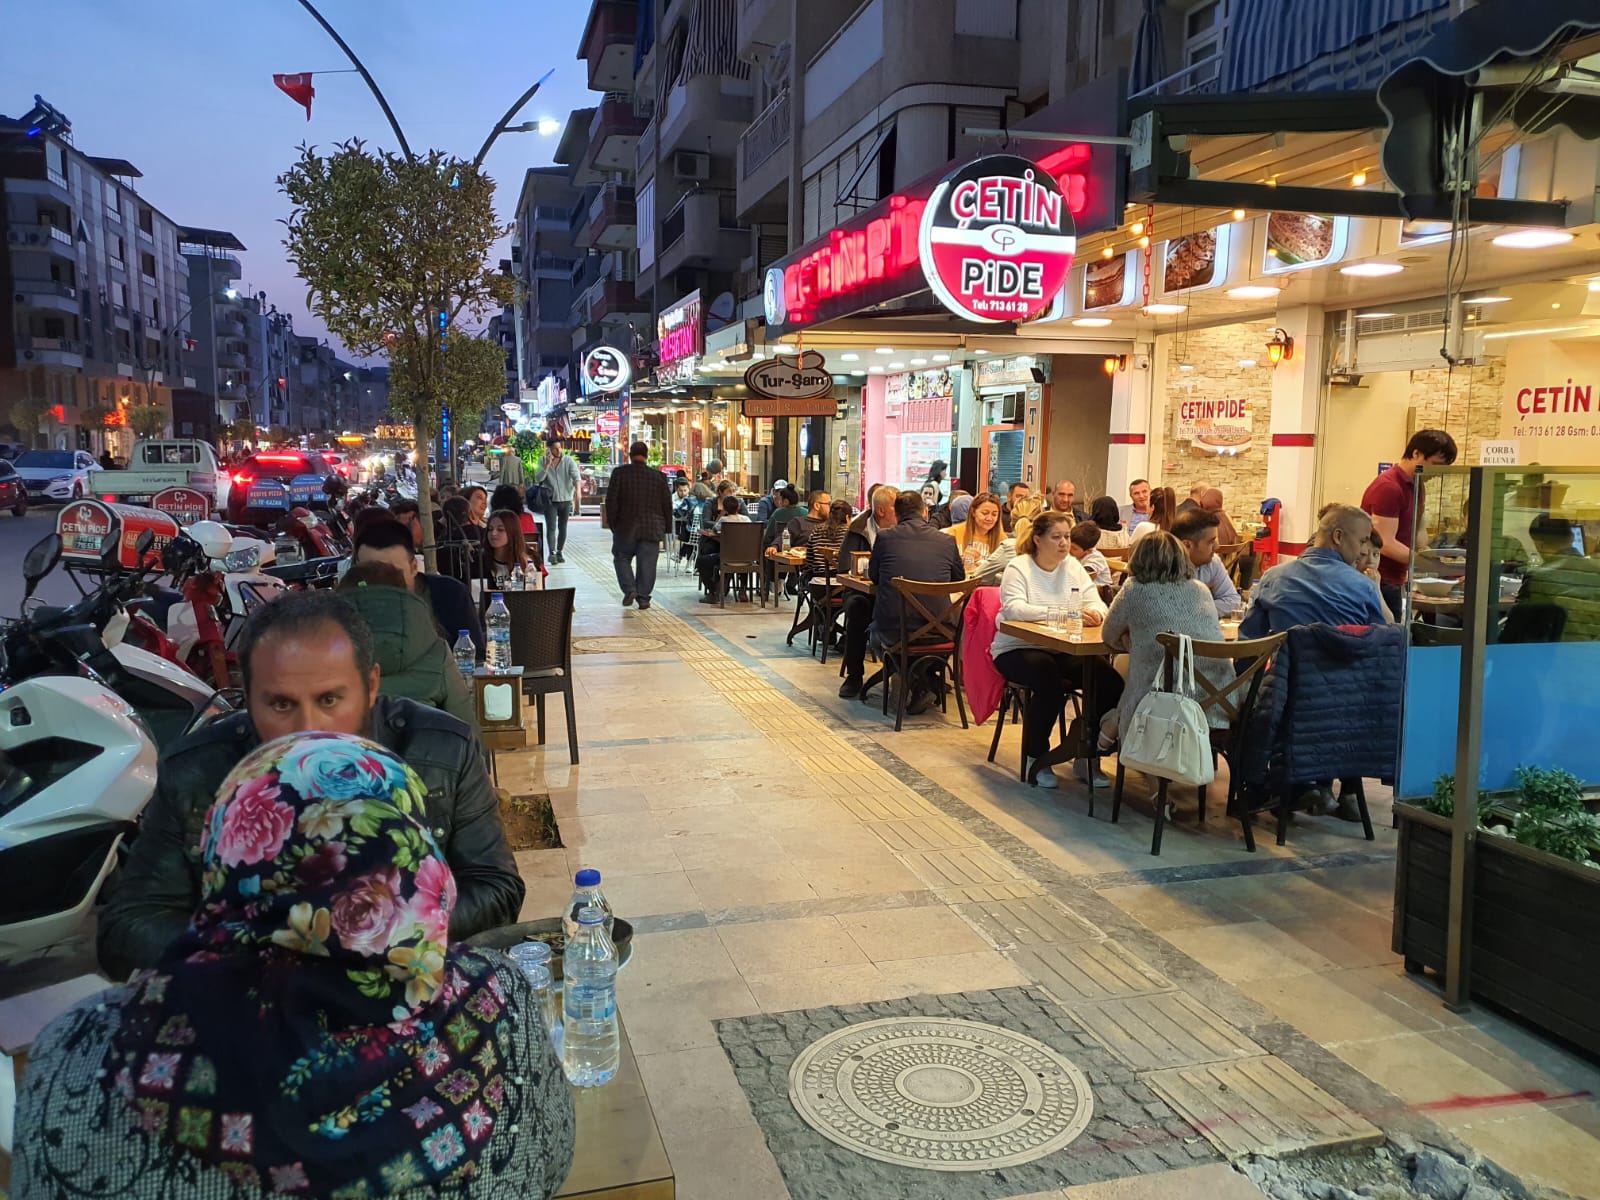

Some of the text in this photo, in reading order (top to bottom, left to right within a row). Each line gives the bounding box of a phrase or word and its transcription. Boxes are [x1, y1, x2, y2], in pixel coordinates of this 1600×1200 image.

[950, 168, 1063, 232] ÇETİN
[989, 300, 1005, 311] 713
[1006, 302, 1016, 311] 61
[1017, 302, 1028, 312] 28
[760, 373, 825, 389] Tur-Şam
[1517, 378, 1592, 421] ÇETİN
[1513, 426, 1527, 436] Tel:
[1529, 425, 1543, 436] 713
[1544, 425, 1554, 436] 61
[1555, 425, 1566, 436] 28
[1567, 425, 1589, 436] Gsm:
[1486, 446, 1514, 455] ÇORBA
